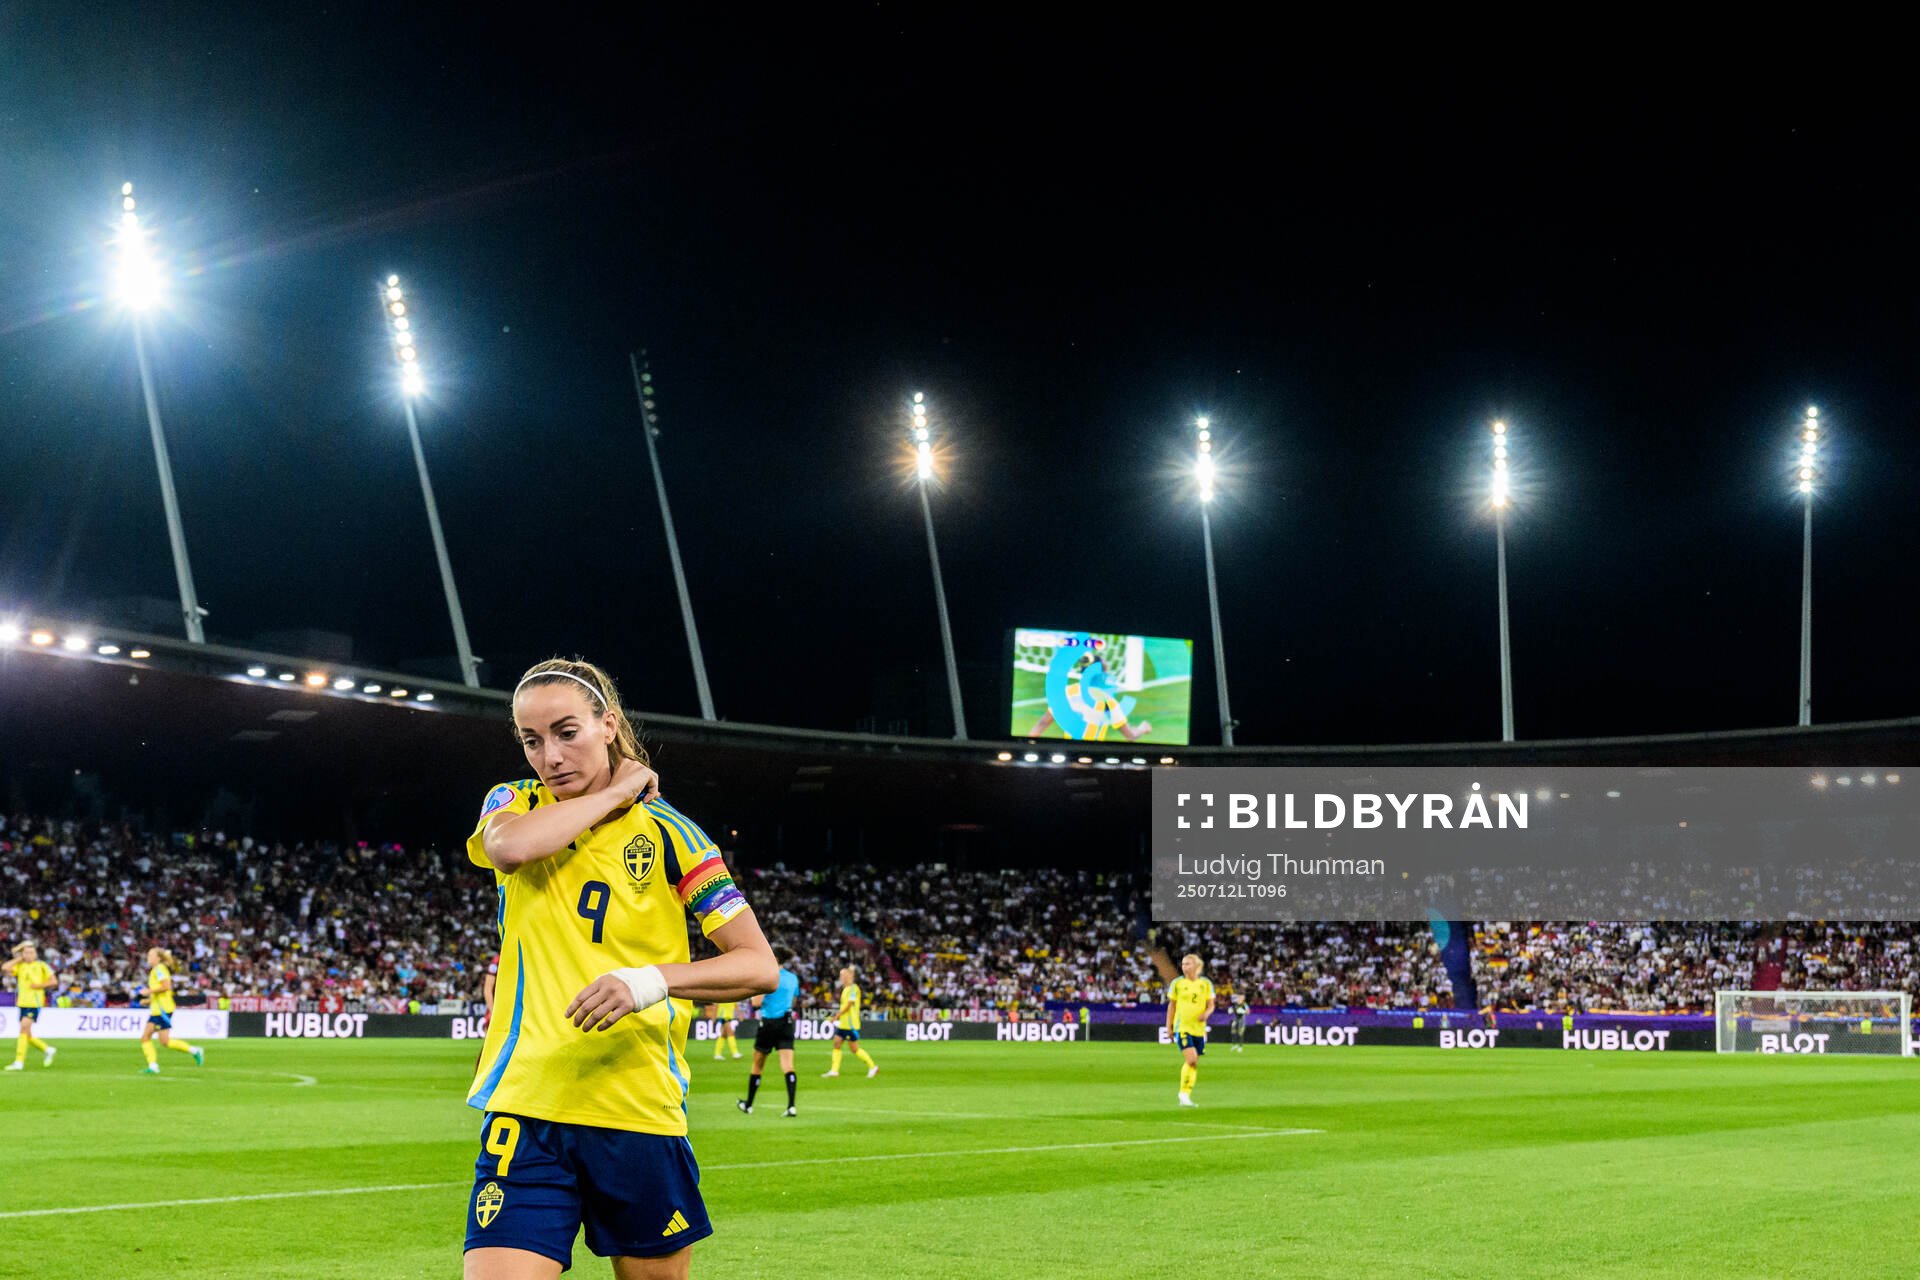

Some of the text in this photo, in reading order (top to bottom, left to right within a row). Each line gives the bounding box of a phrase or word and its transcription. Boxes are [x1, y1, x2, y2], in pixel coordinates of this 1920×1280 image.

[691, 874, 730, 902] RESPECT
[577, 880, 611, 944] 9
[1191, 993, 1198, 1003] 2
[77, 1015, 141, 1031] ZURICH
[265, 1012, 368, 1038] HUBLOT
[906, 1022, 953, 1041] BLOT
[997, 1022, 1080, 1041] HUBLOT
[1264, 1026, 1359, 1046] HUBLOT
[1439, 1029, 1499, 1049] BLOT
[1562, 1029, 1670, 1051] HUBLOT
[1761, 1033, 1829, 1054] BLOT
[486, 1116, 521, 1177] 9
